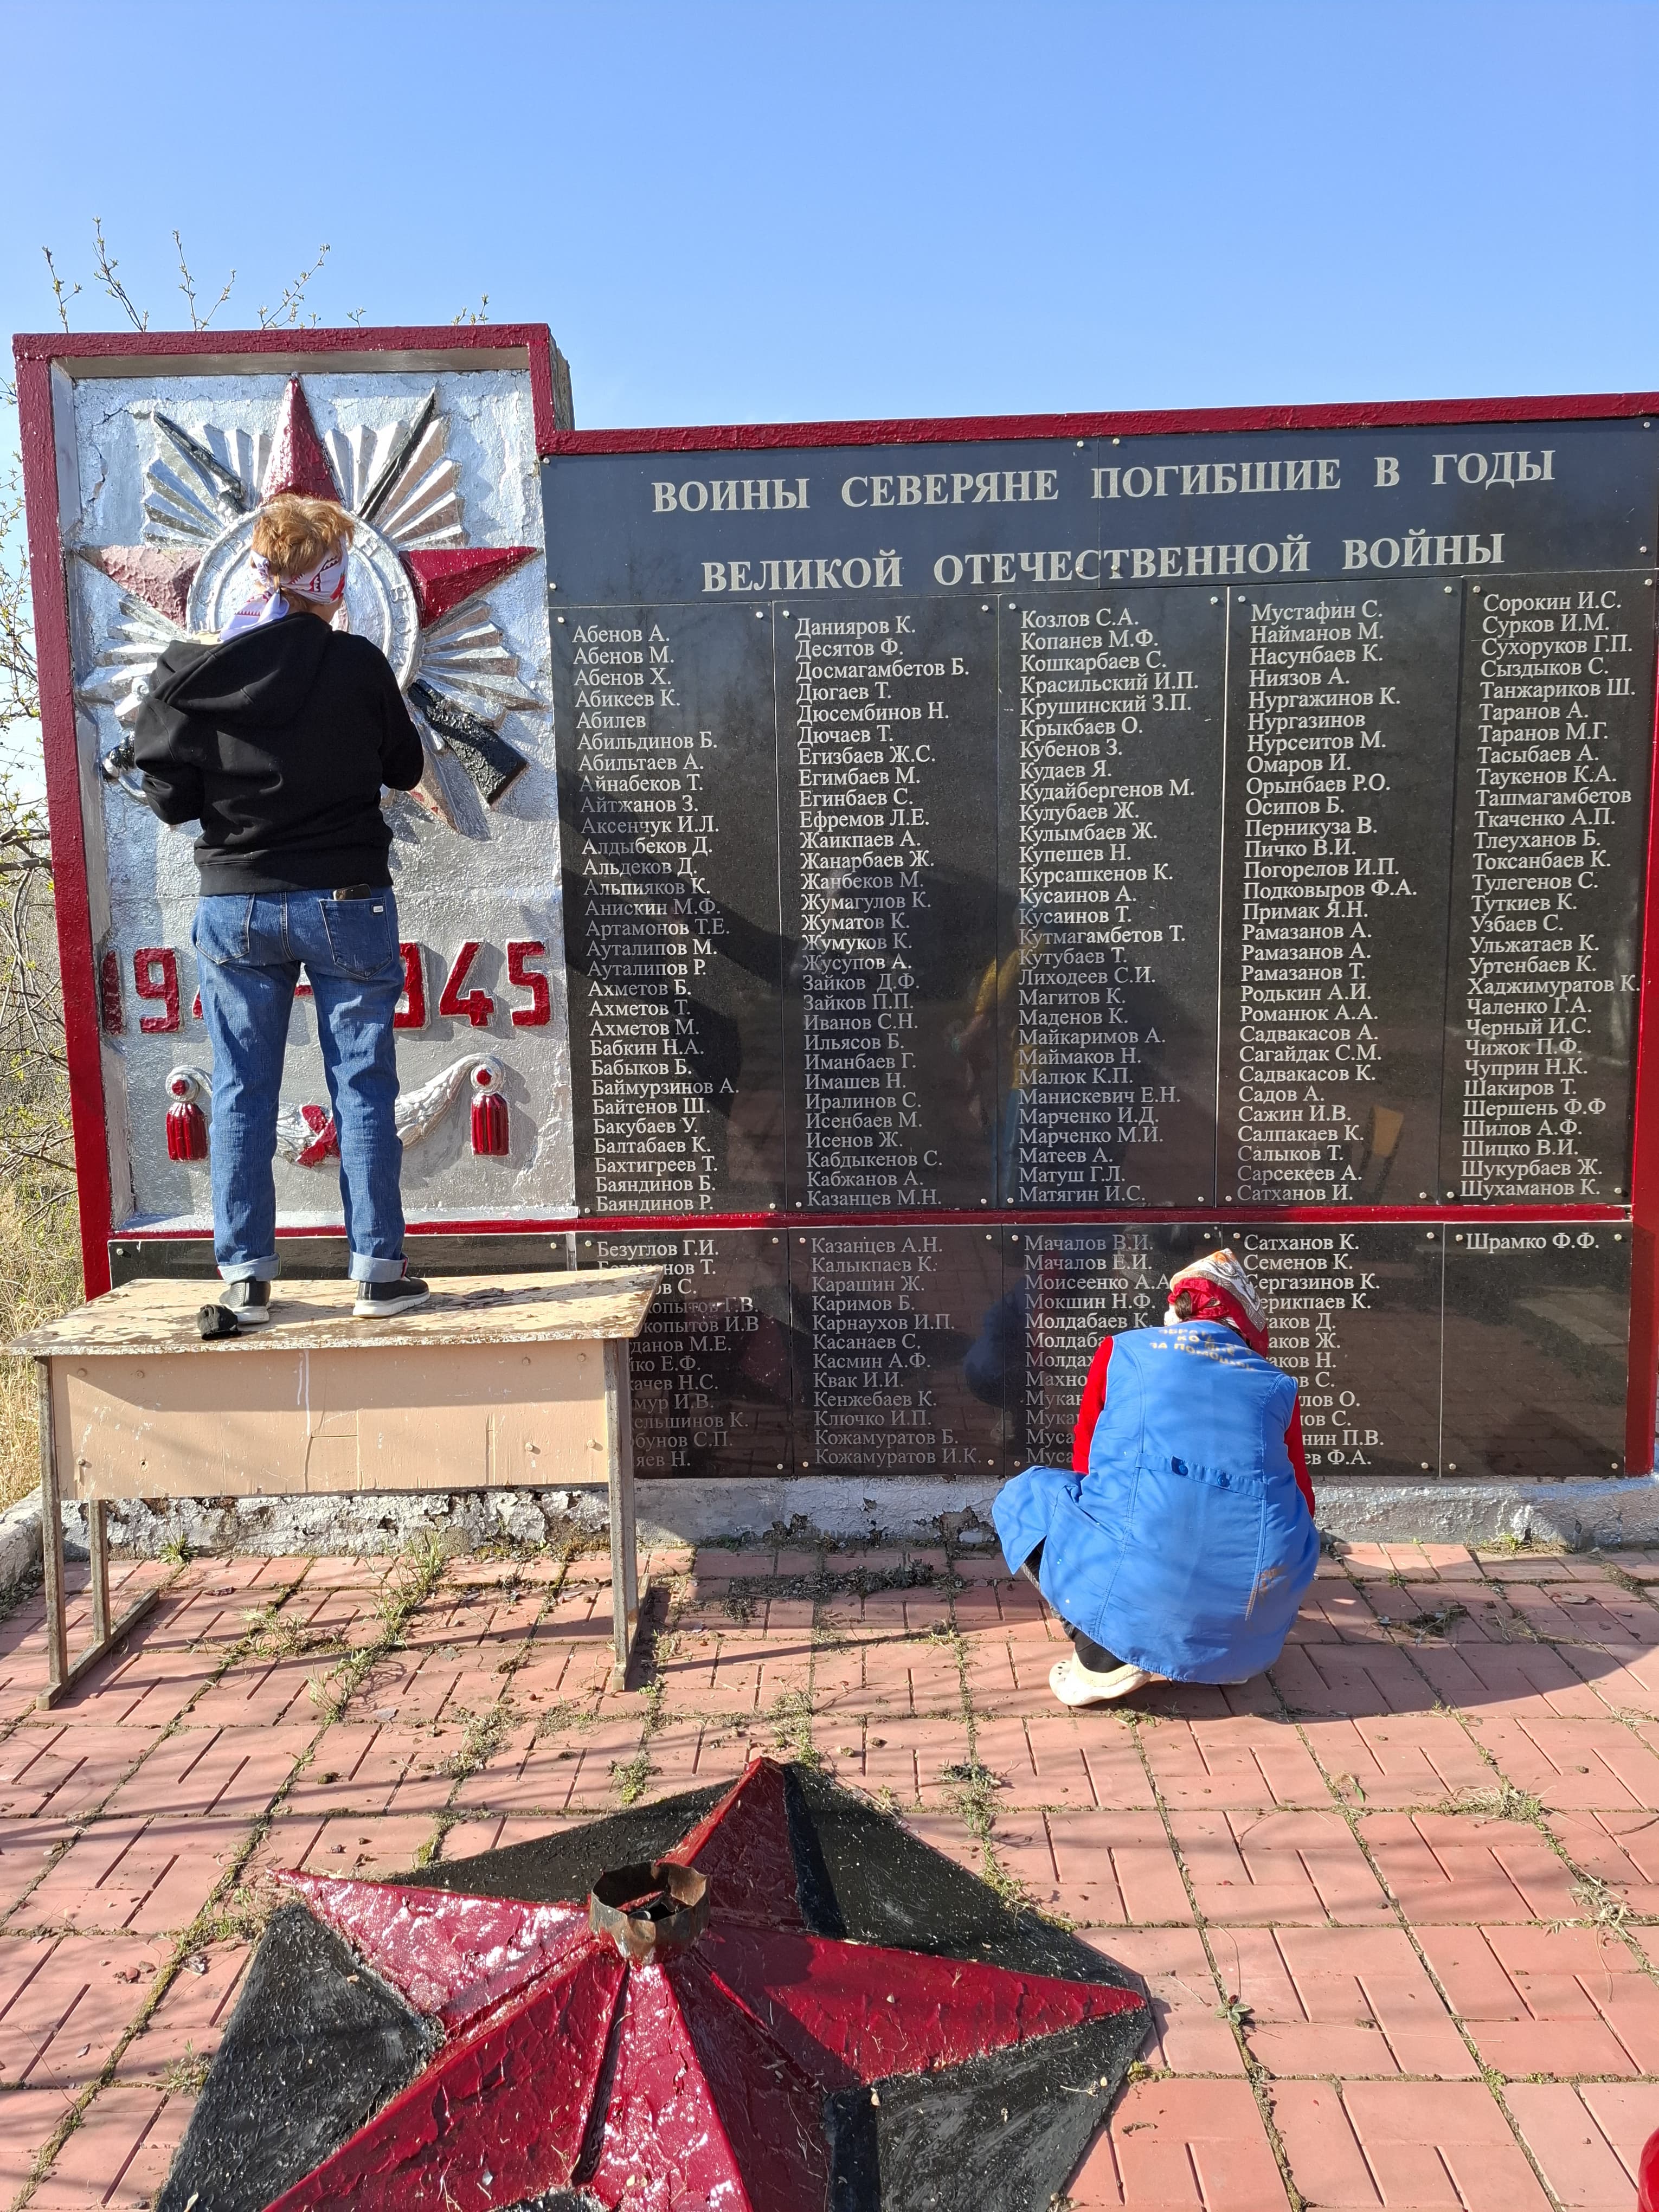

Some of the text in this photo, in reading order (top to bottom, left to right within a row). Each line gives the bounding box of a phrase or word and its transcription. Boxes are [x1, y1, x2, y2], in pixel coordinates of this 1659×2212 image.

[652, 451, 1557, 513] ВОИНЫ СЕВЕРЯНЕ ПОГИБШИЕ В ГОДЫ
[701, 529, 1506, 593] ВЕЛИКОЙ ОТЕЧЕСТВЕННОЙ ВОЙНЫ
[1251, 600, 1382, 627] Мустафин С.
[1483, 590, 1622, 618] Сорокин И.С.
[795, 615, 916, 641] Данияров К.
[1020, 608, 1139, 628] Козлов С.А.
[571, 625, 670, 643] Абенов А.
[1250, 644, 1383, 671] Насунбаев К.
[1481, 634, 1632, 661] Сухоруков Г.П.
[796, 658, 969, 682] Досмагамбетов Б.
[1020, 651, 1166, 678] Кошкарбаев С.
[574, 667, 671, 686] Абенов Х.
[1480, 700, 1589, 726] Таранов А.
[1019, 716, 1143, 743] Крыкбаев О.
[1248, 711, 1366, 736] Нургазинов
[576, 731, 717, 751] Абильдинов Б.
[797, 724, 893, 749] Дючаев Т.
[1477, 744, 1599, 764] Тасыбаев А.
[1019, 760, 1112, 785] Кудаев Я.
[1246, 753, 1351, 778] Омаров И.
[579, 774, 703, 792] Айнабеков Т.
[799, 767, 920, 786] Егимбаев М.
[1476, 807, 1616, 828] Ткаченко А.П.
[800, 830, 921, 848] Жаикпаев А.
[1019, 822, 1158, 848] Кулымбаев Ж.
[1245, 816, 1378, 842] Перникуза В.
[581, 836, 712, 856] Алдыбеков Д.
[1474, 850, 1611, 870] Токсанбаев К.
[800, 871, 923, 890] Жанбеков М.
[1019, 863, 1173, 889] Курсашкенов К.
[1244, 858, 1399, 884] Погорелов И.П.
[583, 877, 710, 895] Альпияков К.
[1242, 922, 1372, 940] Рамазанов А.
[1471, 914, 1564, 933] Узбаев С.
[801, 933, 912, 956] Жумуков К.
[1020, 925, 1185, 950] Кутмагамбетов Т.
[586, 938, 717, 960] Ауталипов М.
[1018, 966, 1155, 986] Лиходеев С.И.
[1240, 962, 1366, 981] Рамазанов Т.
[1470, 955, 1596, 979] Уртенбаев К.
[587, 979, 691, 996] Ахметов Б.
[802, 972, 919, 994] Зайков Д.Ф.
[1019, 1027, 1166, 1049] Майкаримов А.
[1240, 1024, 1378, 1044] Садвакасов А.
[1467, 1017, 1591, 1040] Черный И.С.
[590, 1039, 704, 1056] Бабкин Н.А.
[804, 1033, 904, 1050] Ильясов Б.
[1020, 1068, 1133, 1085] Малюк К.П.
[1239, 1064, 1375, 1083] Садвакасов К.
[1465, 1058, 1588, 1082] Чуприн Н.К.
[591, 1078, 739, 1099] Баймурзинов А.
[805, 1072, 906, 1089] Имашев Н.
[1238, 1124, 1364, 1141] Салпакаев К.
[1462, 1118, 1582, 1136] Шилов А.Ф.
[594, 1136, 711, 1153] Балтабаев К.
[806, 1131, 903, 1148] Исенов Ж.
[1019, 1126, 1163, 1149] Марченко М.И.
[807, 1170, 923, 1187] Кабжанов А.
[1019, 1166, 1126, 1187] Матуш Г.Л.
[1237, 1165, 1362, 1185] Сарсекеев А.
[1461, 1158, 1603, 1181] Шукурбаев Ж.
[596, 1175, 716, 1193] Баяндинов Б.
[597, 1240, 719, 1261] Безуглов Г.И.
[811, 1237, 942, 1255] Казанцев А.Н.
[1024, 1234, 1153, 1252] Мачалов В.И.
[1244, 1233, 1359, 1250] Сатханов К.
[1466, 1232, 1599, 1253] Шрамко Ф.Ф.
[812, 1275, 924, 1297] Карашин Ж.
[1026, 1293, 1155, 1309] Мокшин Н.Ф.
[813, 1314, 955, 1335] Карнаухов И.П.
[813, 1352, 930, 1368] Касмин А.Ф.
[813, 1372, 904, 1387] Квак И.И.
